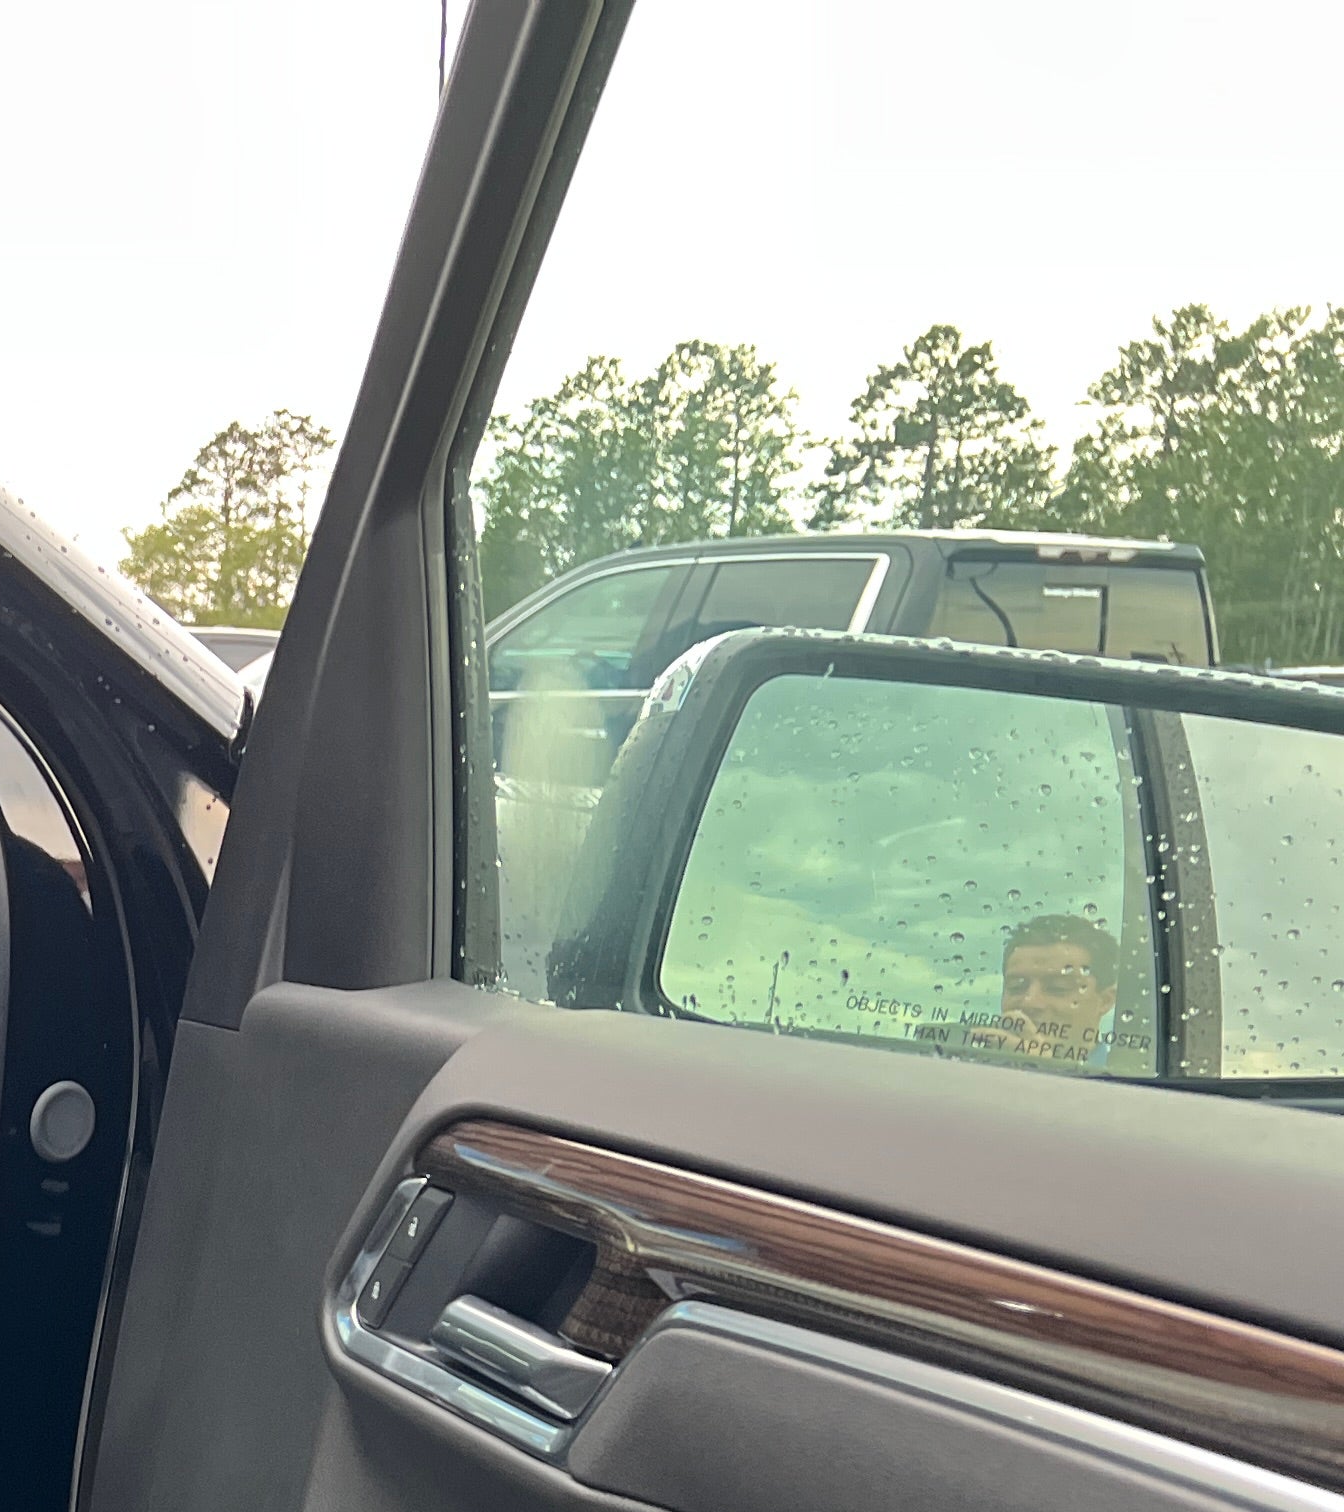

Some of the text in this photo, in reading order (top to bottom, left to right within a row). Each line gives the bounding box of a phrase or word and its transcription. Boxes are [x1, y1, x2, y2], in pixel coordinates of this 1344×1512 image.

[845, 995, 1151, 1050] OBJECTS IN MIRROR ARE CLOSER
[904, 1023, 1089, 1062] THAN THEY APPEAR
